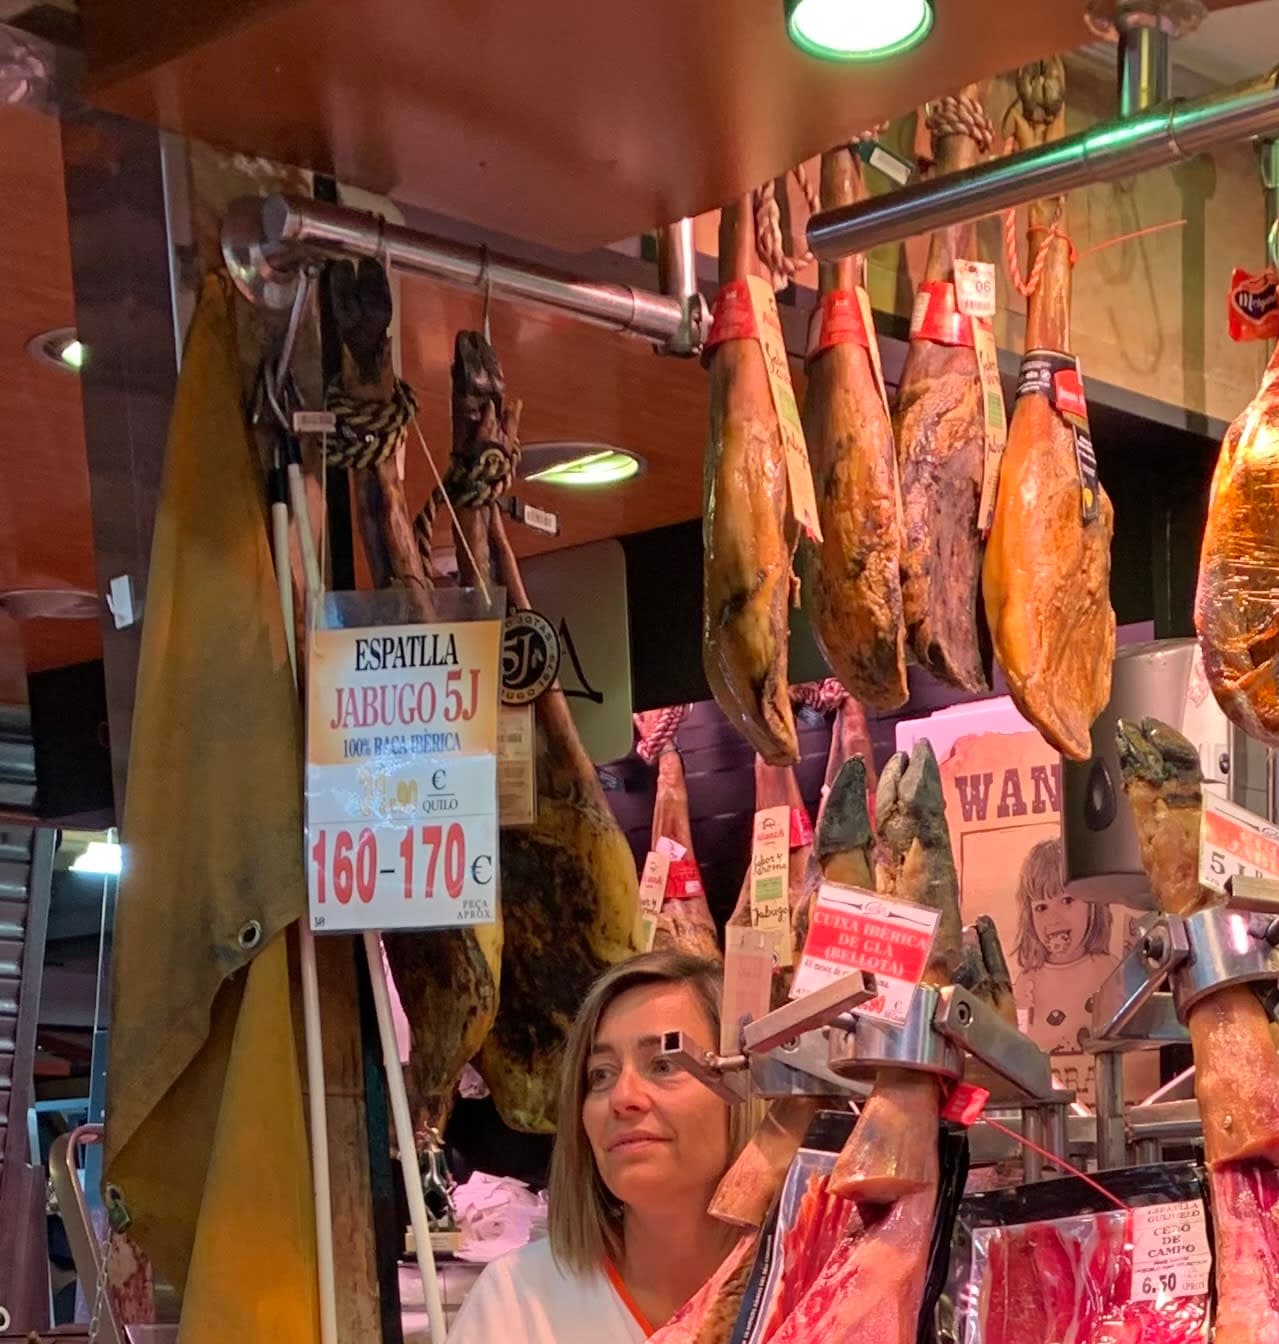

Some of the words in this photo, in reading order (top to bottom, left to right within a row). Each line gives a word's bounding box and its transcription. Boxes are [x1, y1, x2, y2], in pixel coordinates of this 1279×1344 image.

[355, 633, 458, 671] ESPATLLA
[330, 682, 436, 729] JABUGO
[444, 669, 480, 722] 5J
[344, 739, 370, 758] 100%
[411, 728, 461, 754] IBÈRICA
[432, 769, 446, 791] €
[422, 798, 458, 813] QUILO
[471, 855, 492, 884] €
[463, 900, 487, 912] PEÇA
[814, 912, 859, 932] CUIXA
[838, 933, 859, 947] DE
[824, 945, 904, 977] (BELLOTA)
[1154, 1223, 1191, 1236] CEO
[1162, 1235, 1180, 1245] DE
[1148, 1245, 1195, 1257] CAMPO
[1142, 1273, 1177, 1294] 6.50
